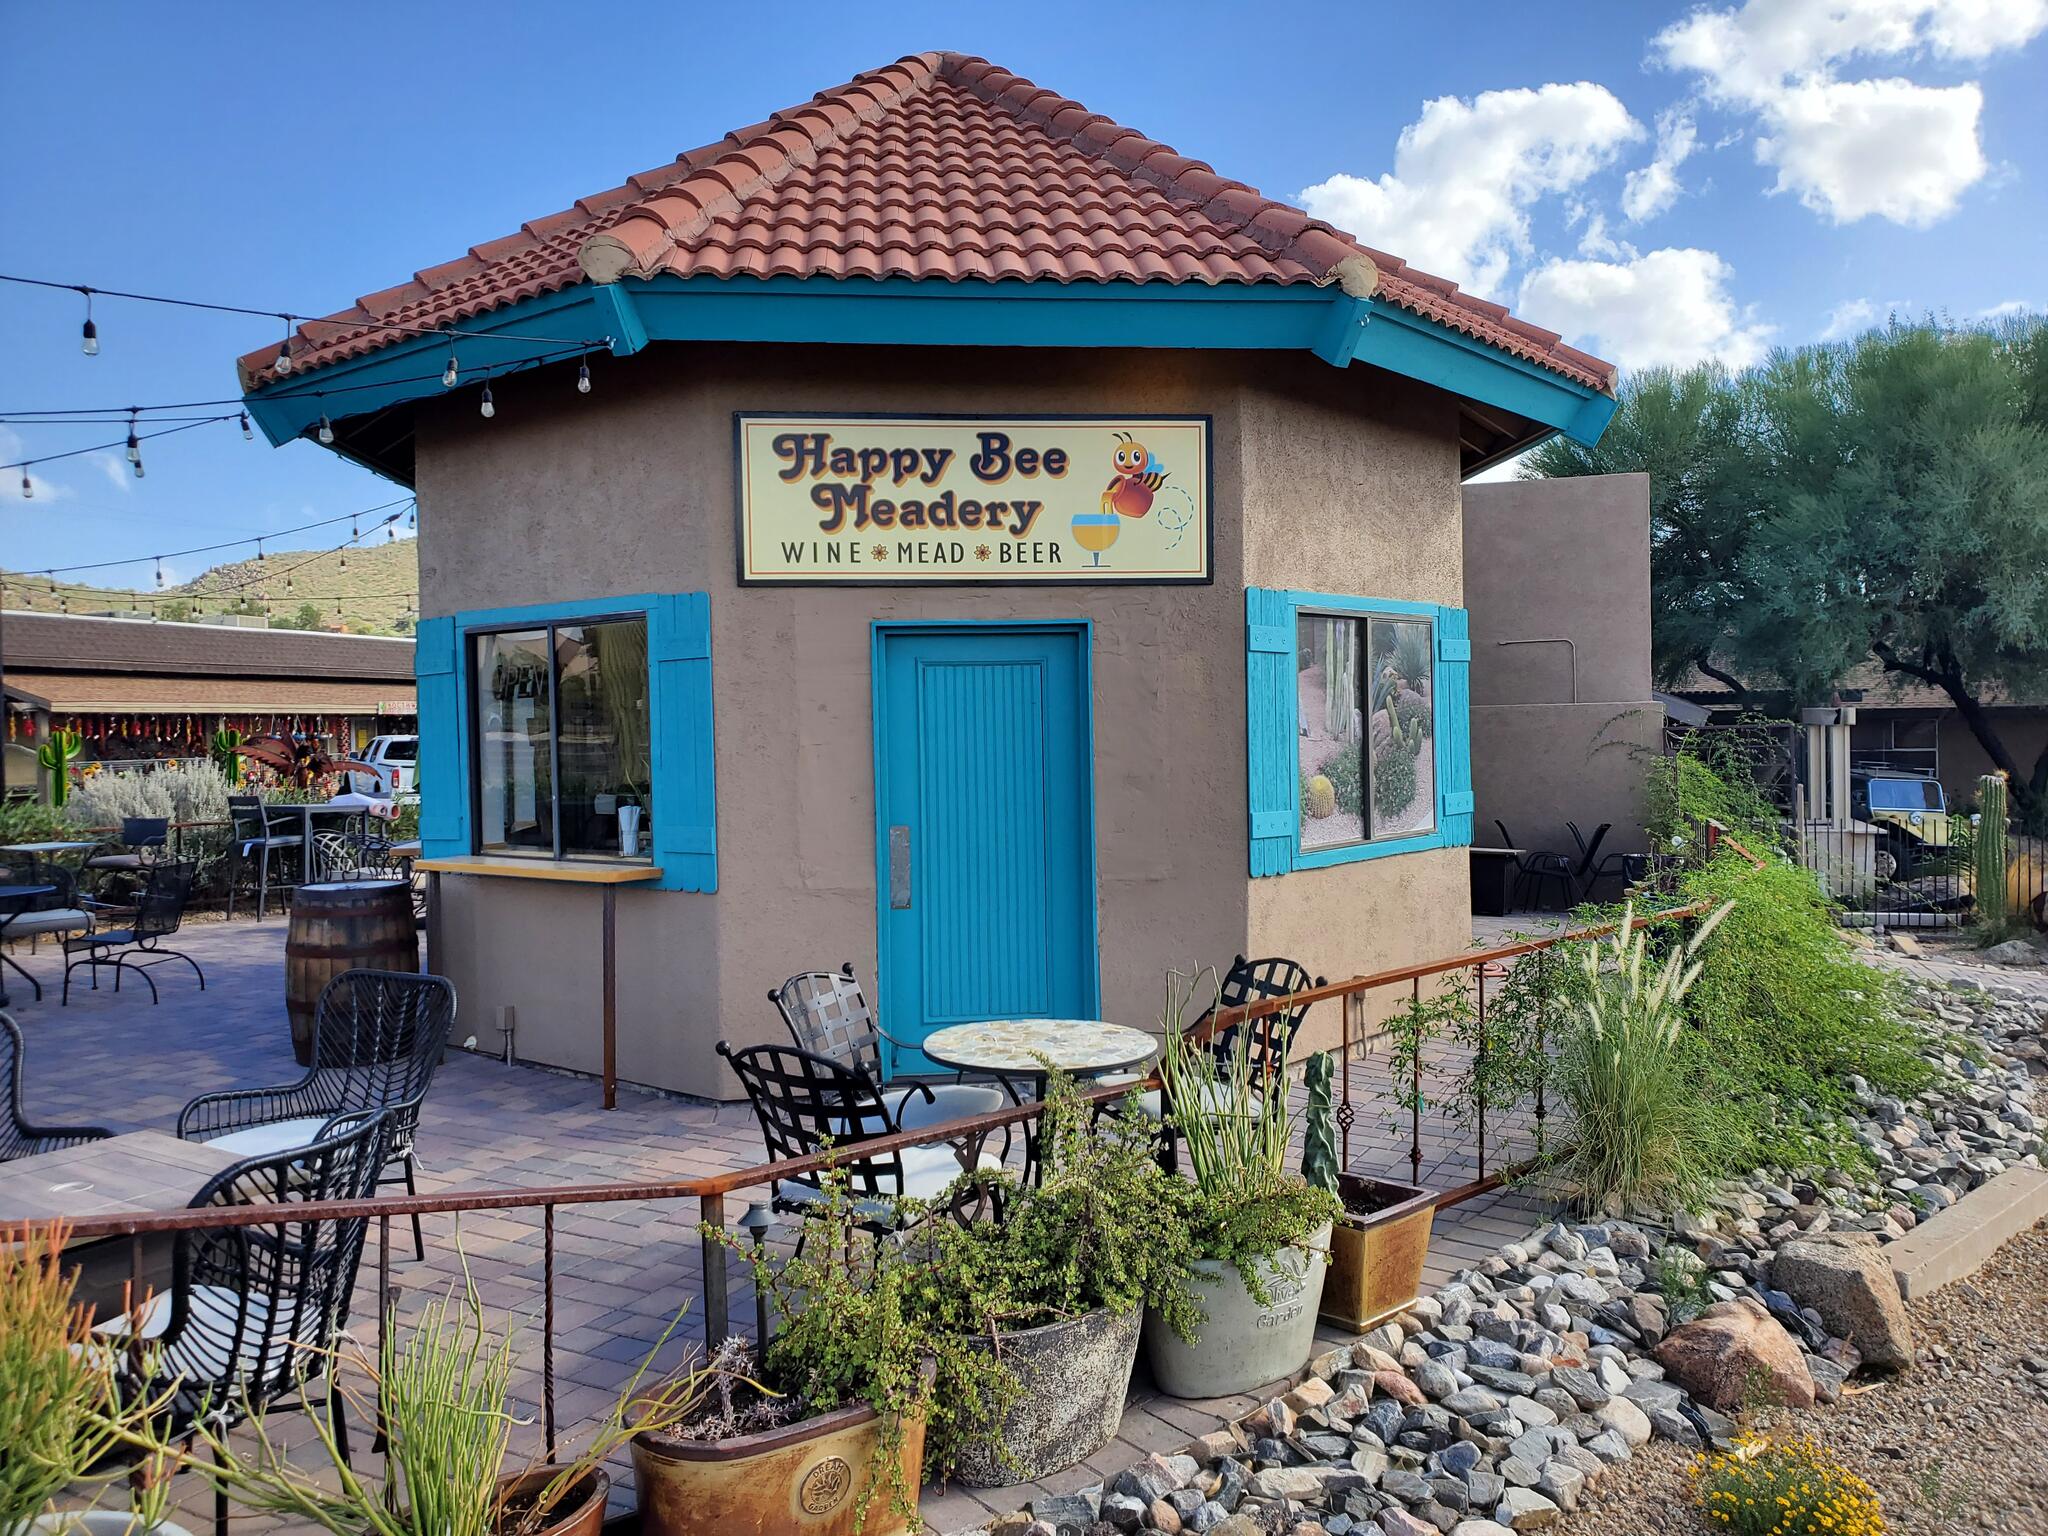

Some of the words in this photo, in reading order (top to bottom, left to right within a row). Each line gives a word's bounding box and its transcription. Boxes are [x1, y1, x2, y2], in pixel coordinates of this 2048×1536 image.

[772, 433, 956, 488] Happy
[970, 432, 1070, 485] Bee
[811, 483, 1044, 539] Meadery
[781, 541, 862, 564] WINE
[897, 541, 965, 564] MEAD
[1000, 541, 1062, 564] BEER
[493, 664, 546, 699] OPEN
[1256, 1303, 1304, 1329] Garden
[812, 1459, 844, 1479] DREAM
[808, 1496, 839, 1511] GARDEN
